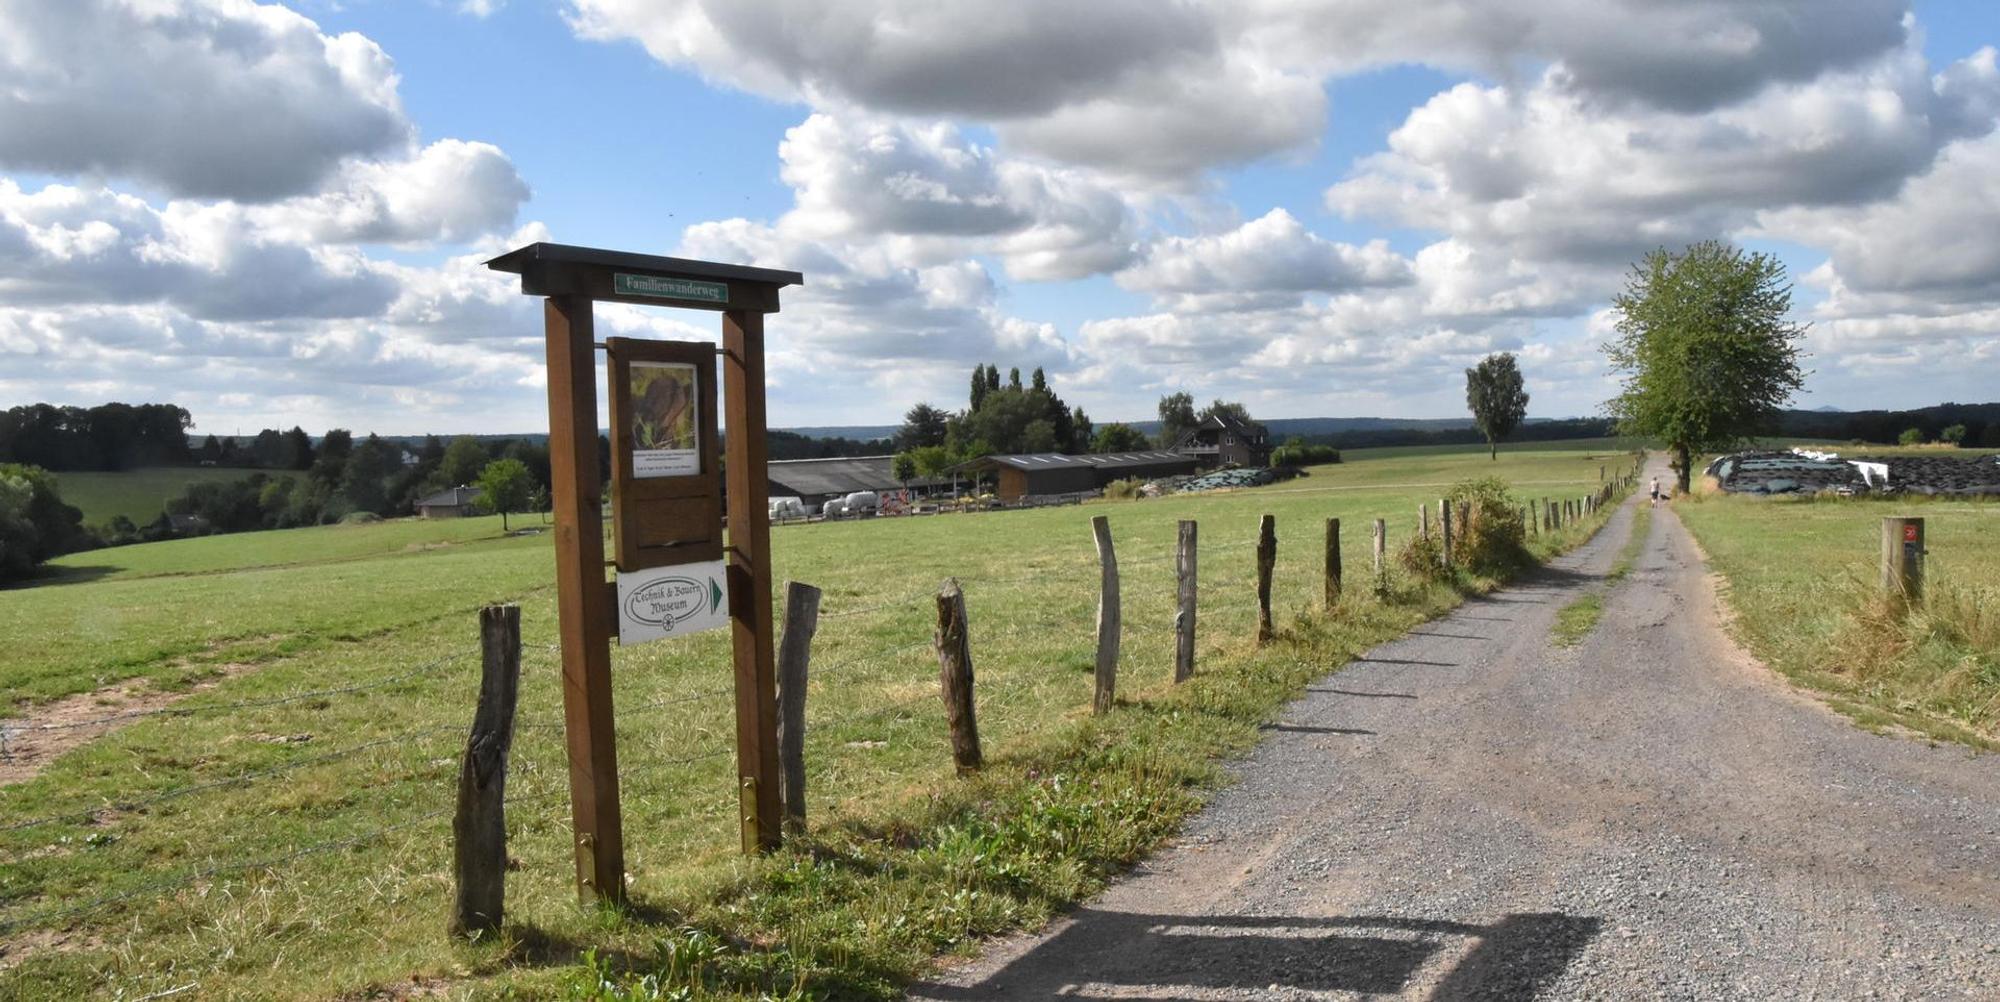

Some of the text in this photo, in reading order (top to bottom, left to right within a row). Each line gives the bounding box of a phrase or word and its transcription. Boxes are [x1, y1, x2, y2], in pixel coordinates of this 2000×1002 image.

[626, 276, 719, 299] Familienwanderweg
[634, 585, 701, 603] Technik & Bauern
[650, 600, 688, 615] Museum
